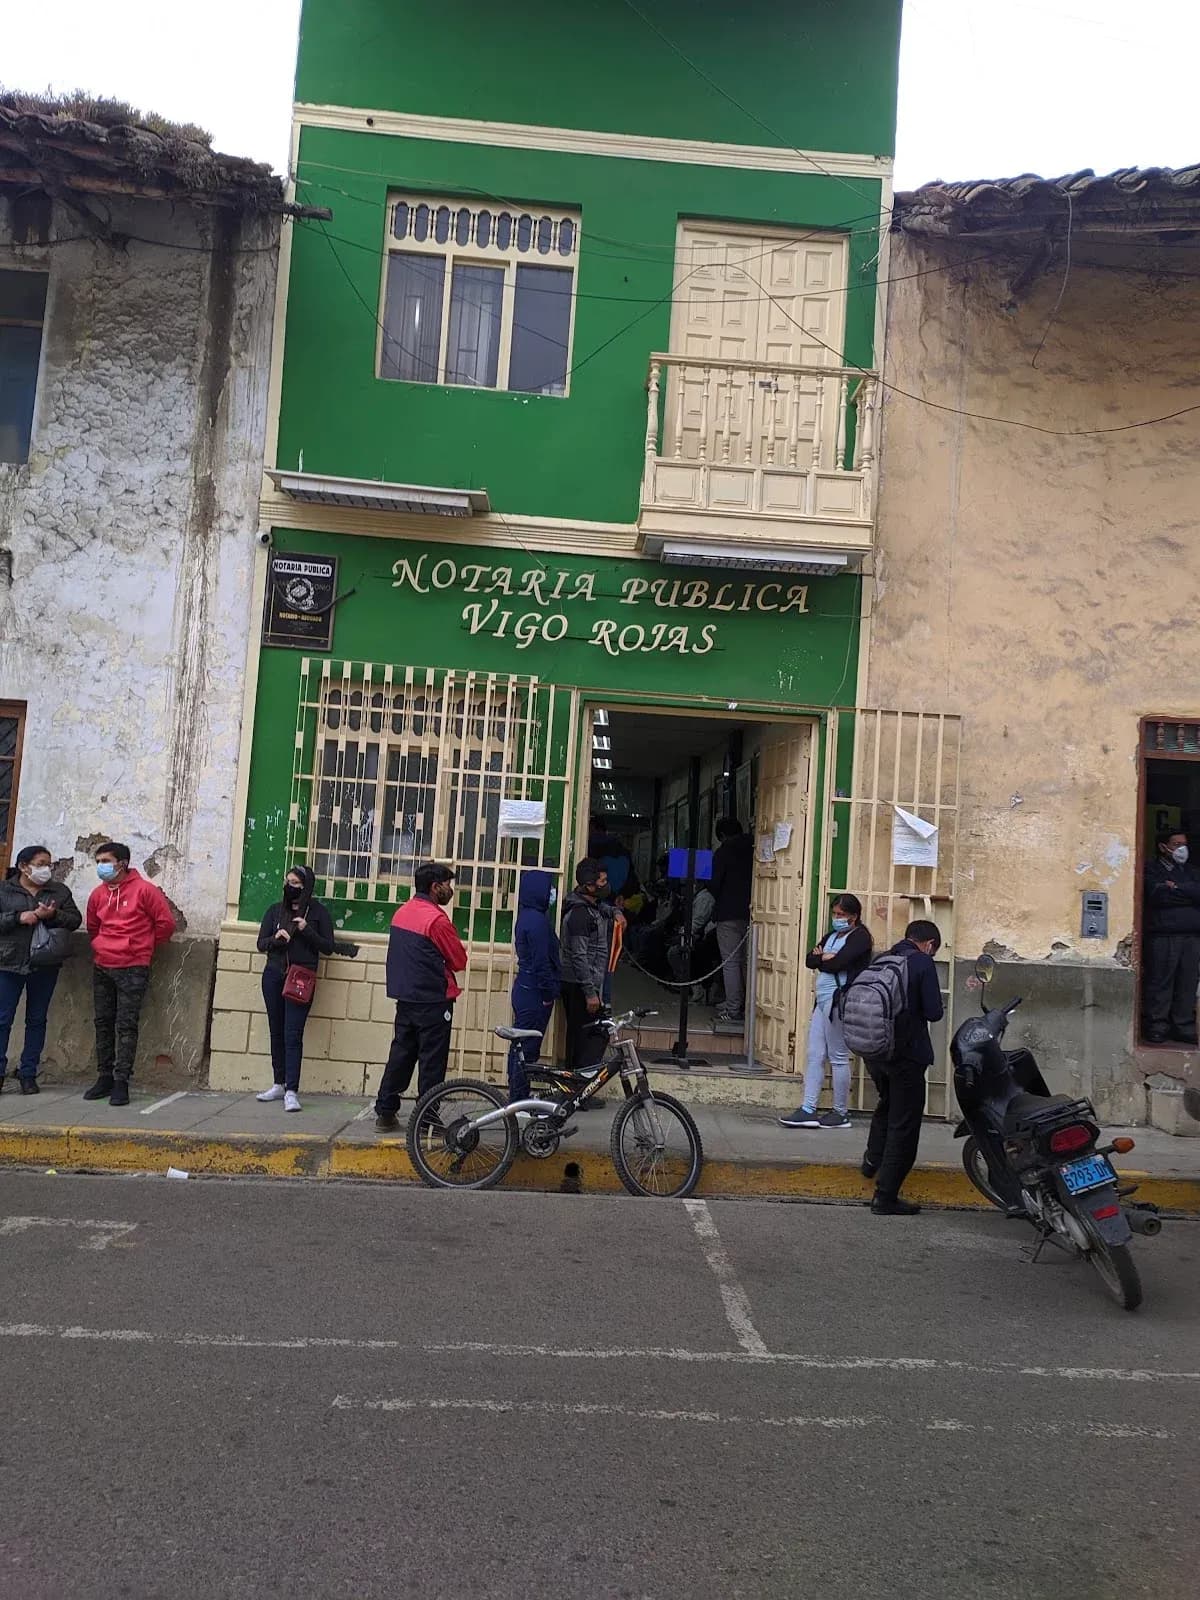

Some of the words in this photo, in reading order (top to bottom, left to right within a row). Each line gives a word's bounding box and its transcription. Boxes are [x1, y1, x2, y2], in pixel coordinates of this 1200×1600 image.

[273, 561, 302, 572] NOTARIA
[391, 553, 596, 605] NOTARIA
[619, 577, 810, 614] PUBLICA
[461, 598, 569, 650] VIGO
[588, 618, 718, 657] ROJAS
